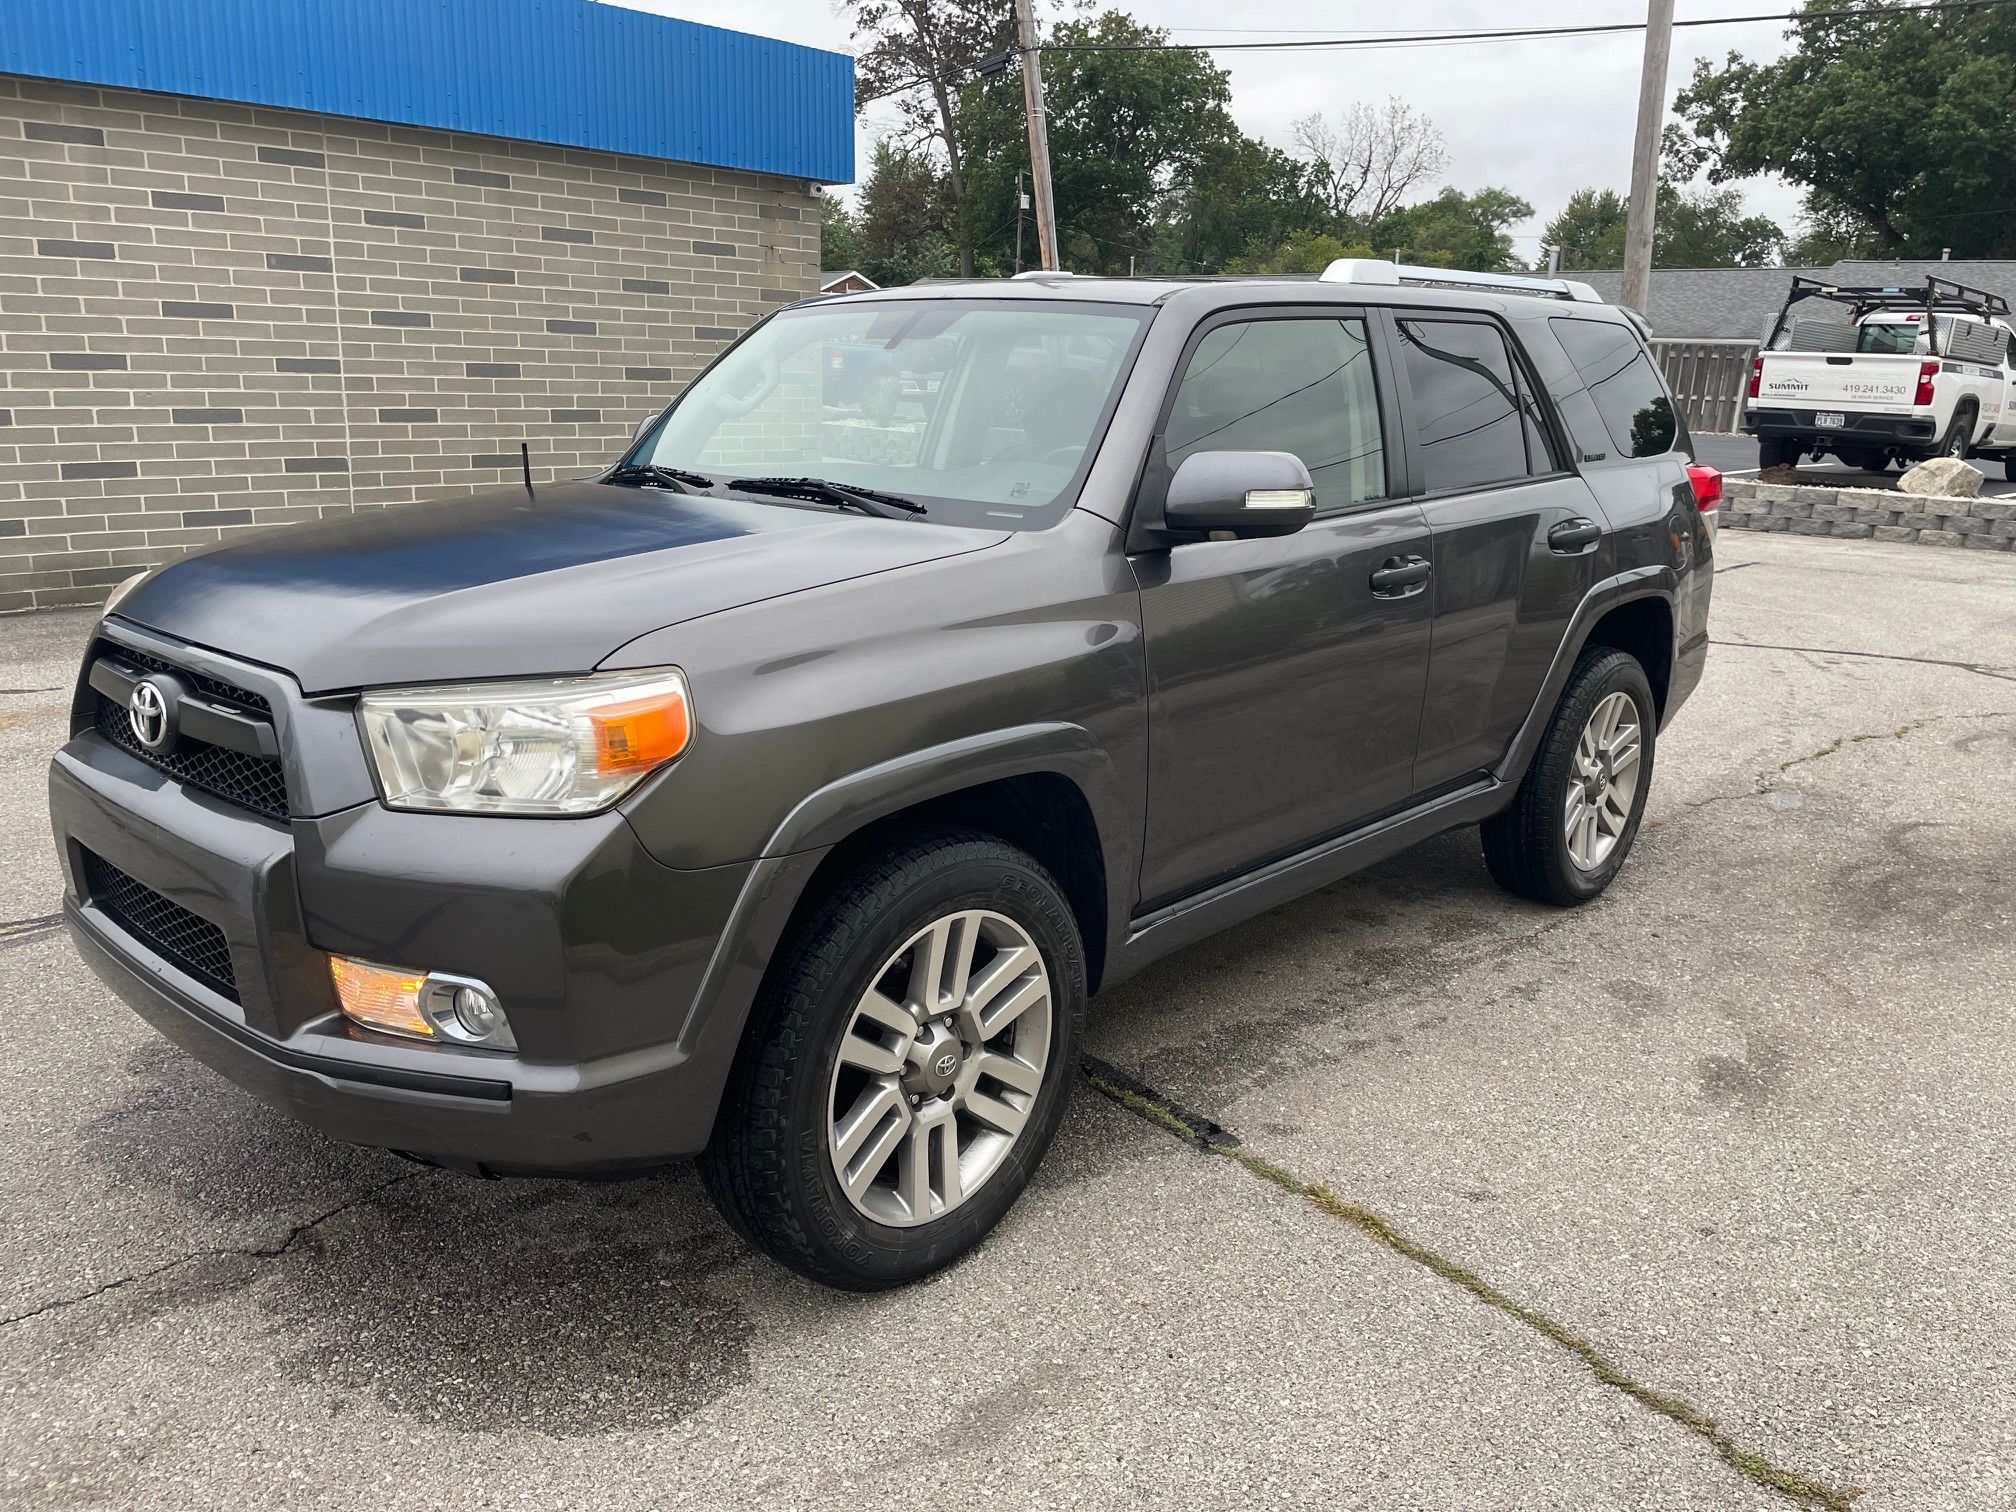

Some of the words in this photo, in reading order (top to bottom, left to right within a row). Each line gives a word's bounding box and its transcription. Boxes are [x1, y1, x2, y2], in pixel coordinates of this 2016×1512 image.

[1768, 382, 1810, 391] SUMMIT
[1842, 384, 1907, 395] 419.241.3430
[799, 1128, 876, 1266] YOKOHAMA
